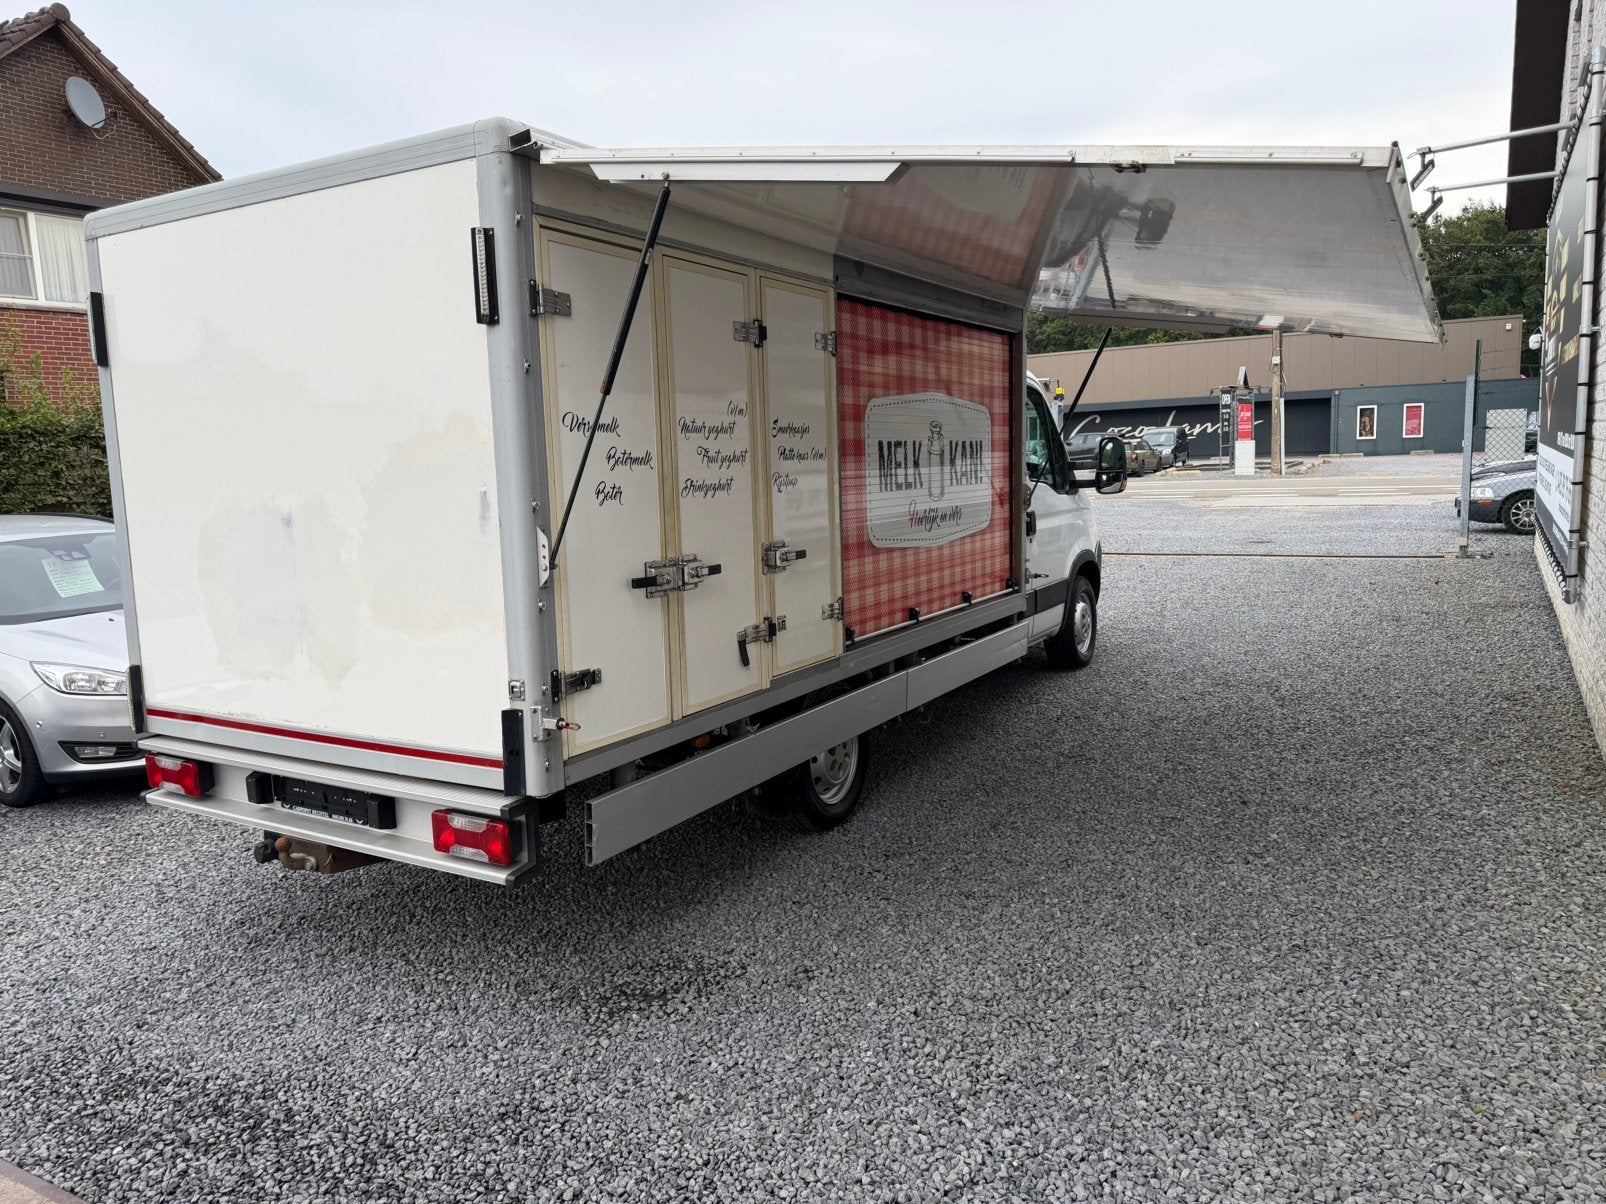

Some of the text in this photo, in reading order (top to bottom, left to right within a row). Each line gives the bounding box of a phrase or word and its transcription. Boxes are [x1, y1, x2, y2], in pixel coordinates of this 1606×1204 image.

[606, 446, 654, 471] Botermelk
[697, 446, 720, 469] Fruit
[878, 440, 923, 492] MELK
[595, 481, 624, 506] Boter
